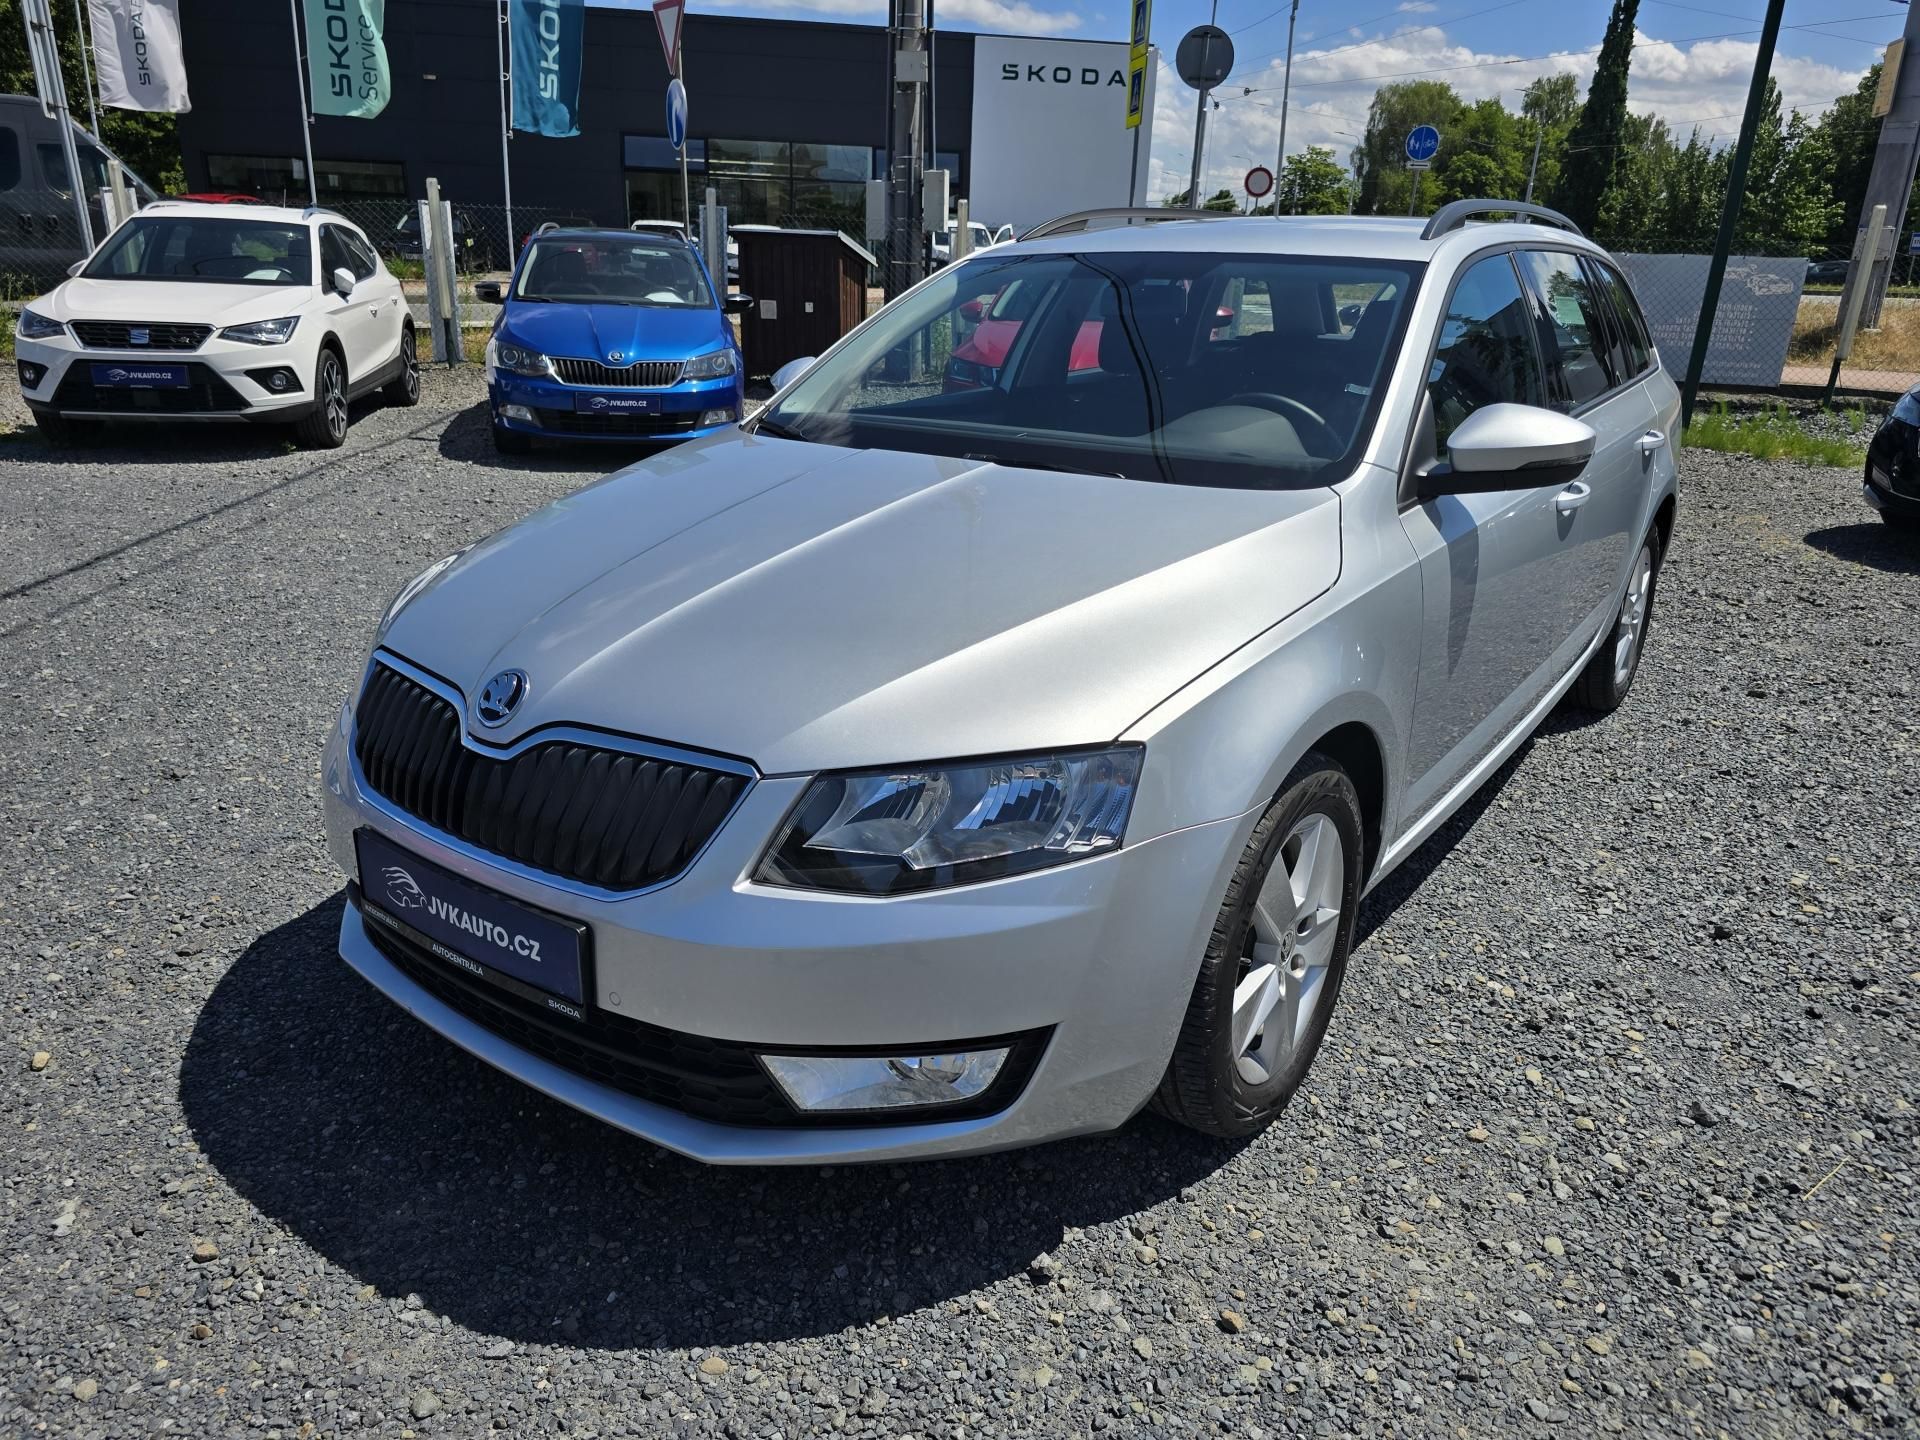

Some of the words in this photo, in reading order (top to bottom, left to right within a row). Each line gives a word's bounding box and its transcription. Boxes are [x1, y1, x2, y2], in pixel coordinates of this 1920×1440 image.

[358, 14, 378, 100] Service
[129, 371, 172, 380] JVKAUTO.CZ
[609, 399, 647, 408] JVKAUTO.CZ
[427, 895, 542, 962] JVKAUTO.CZ
[432, 942, 484, 977] AUTOCENTRÁLA
